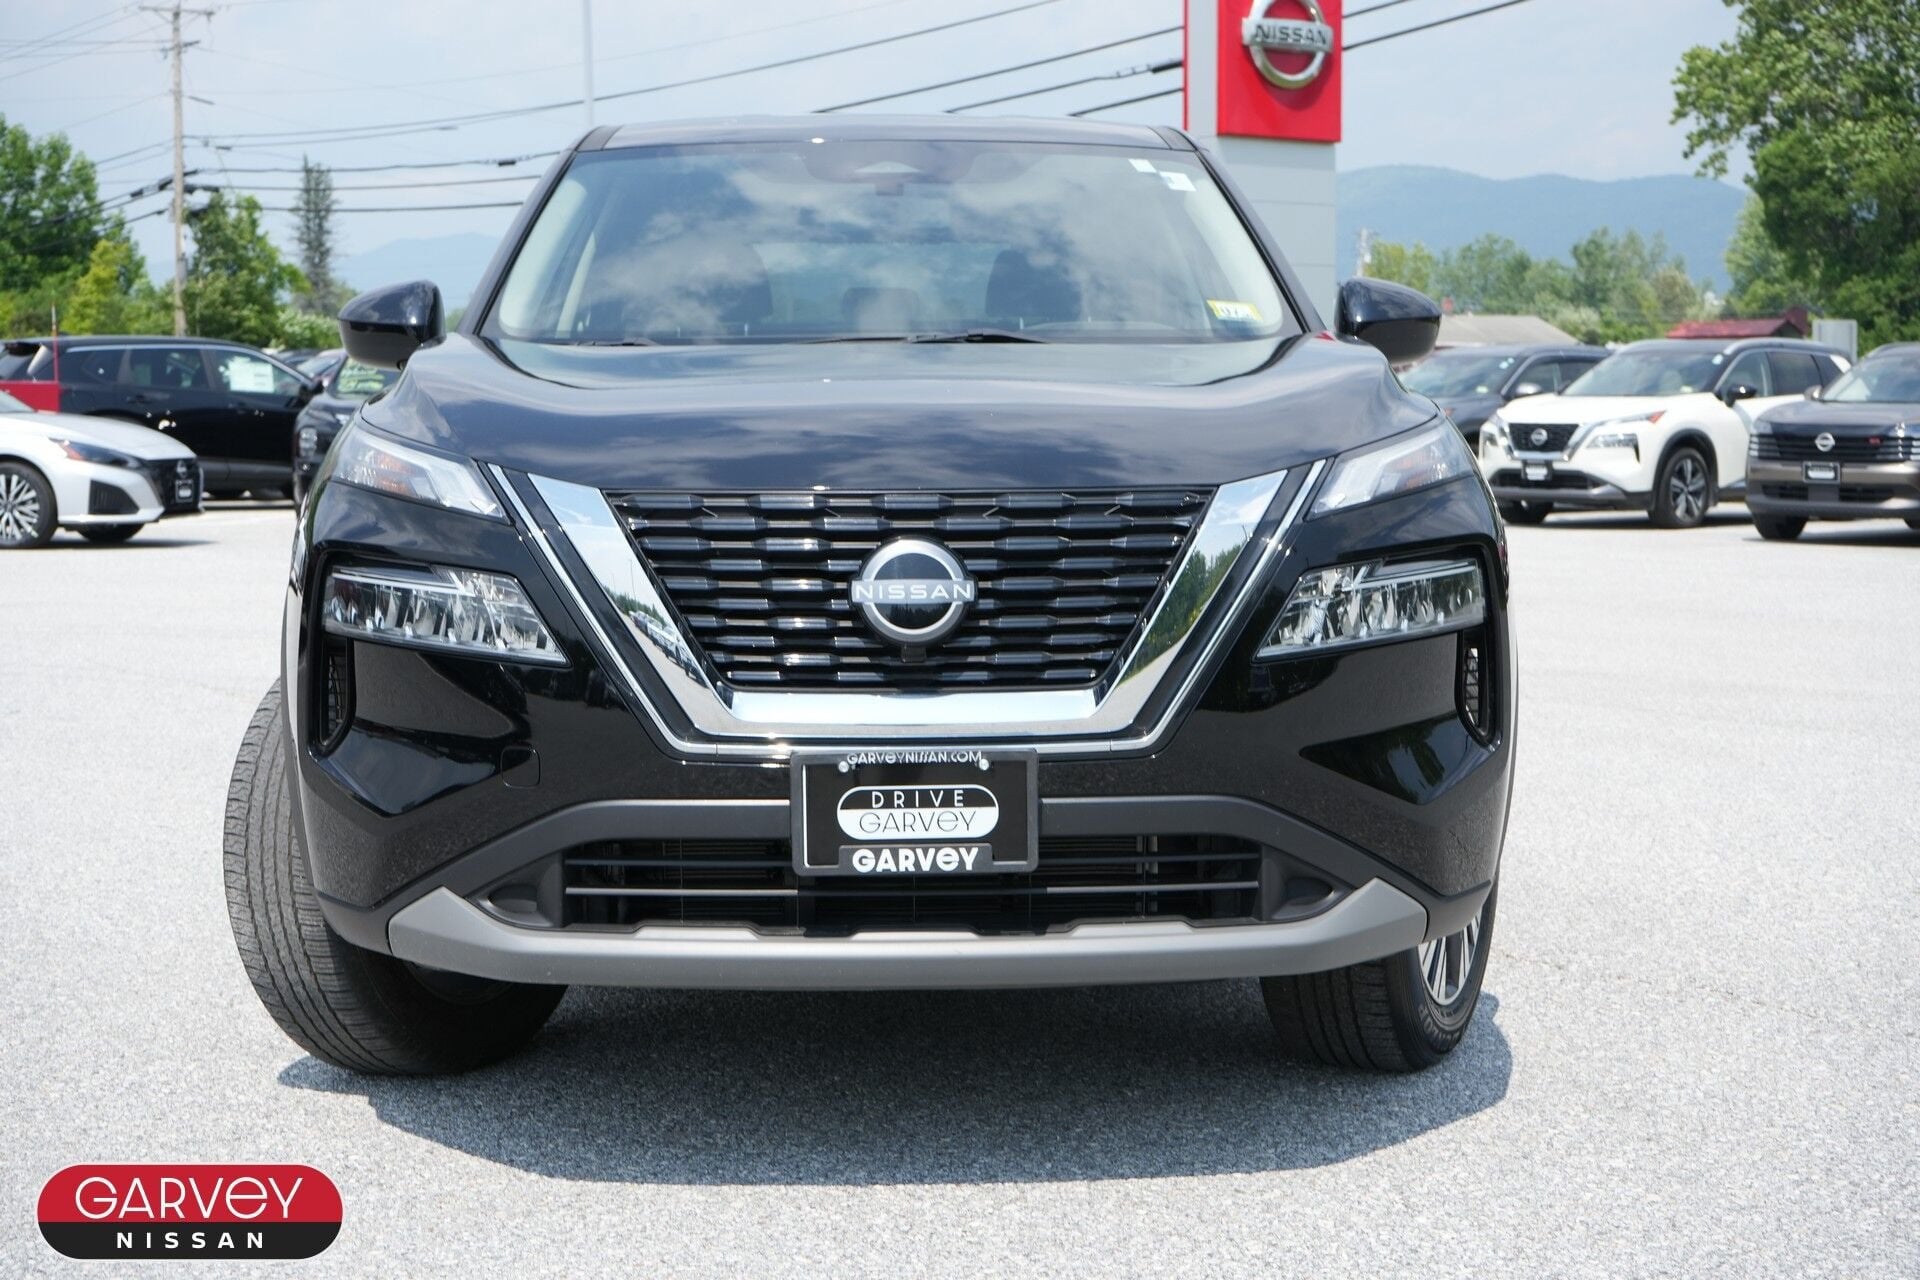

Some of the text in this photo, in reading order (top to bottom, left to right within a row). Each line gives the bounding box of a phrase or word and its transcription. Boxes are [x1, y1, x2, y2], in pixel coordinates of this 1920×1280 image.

[1254, 24, 1327, 46] NISSAN
[856, 583, 972, 600] NISSAN
[871, 789, 965, 808] DRIVE
